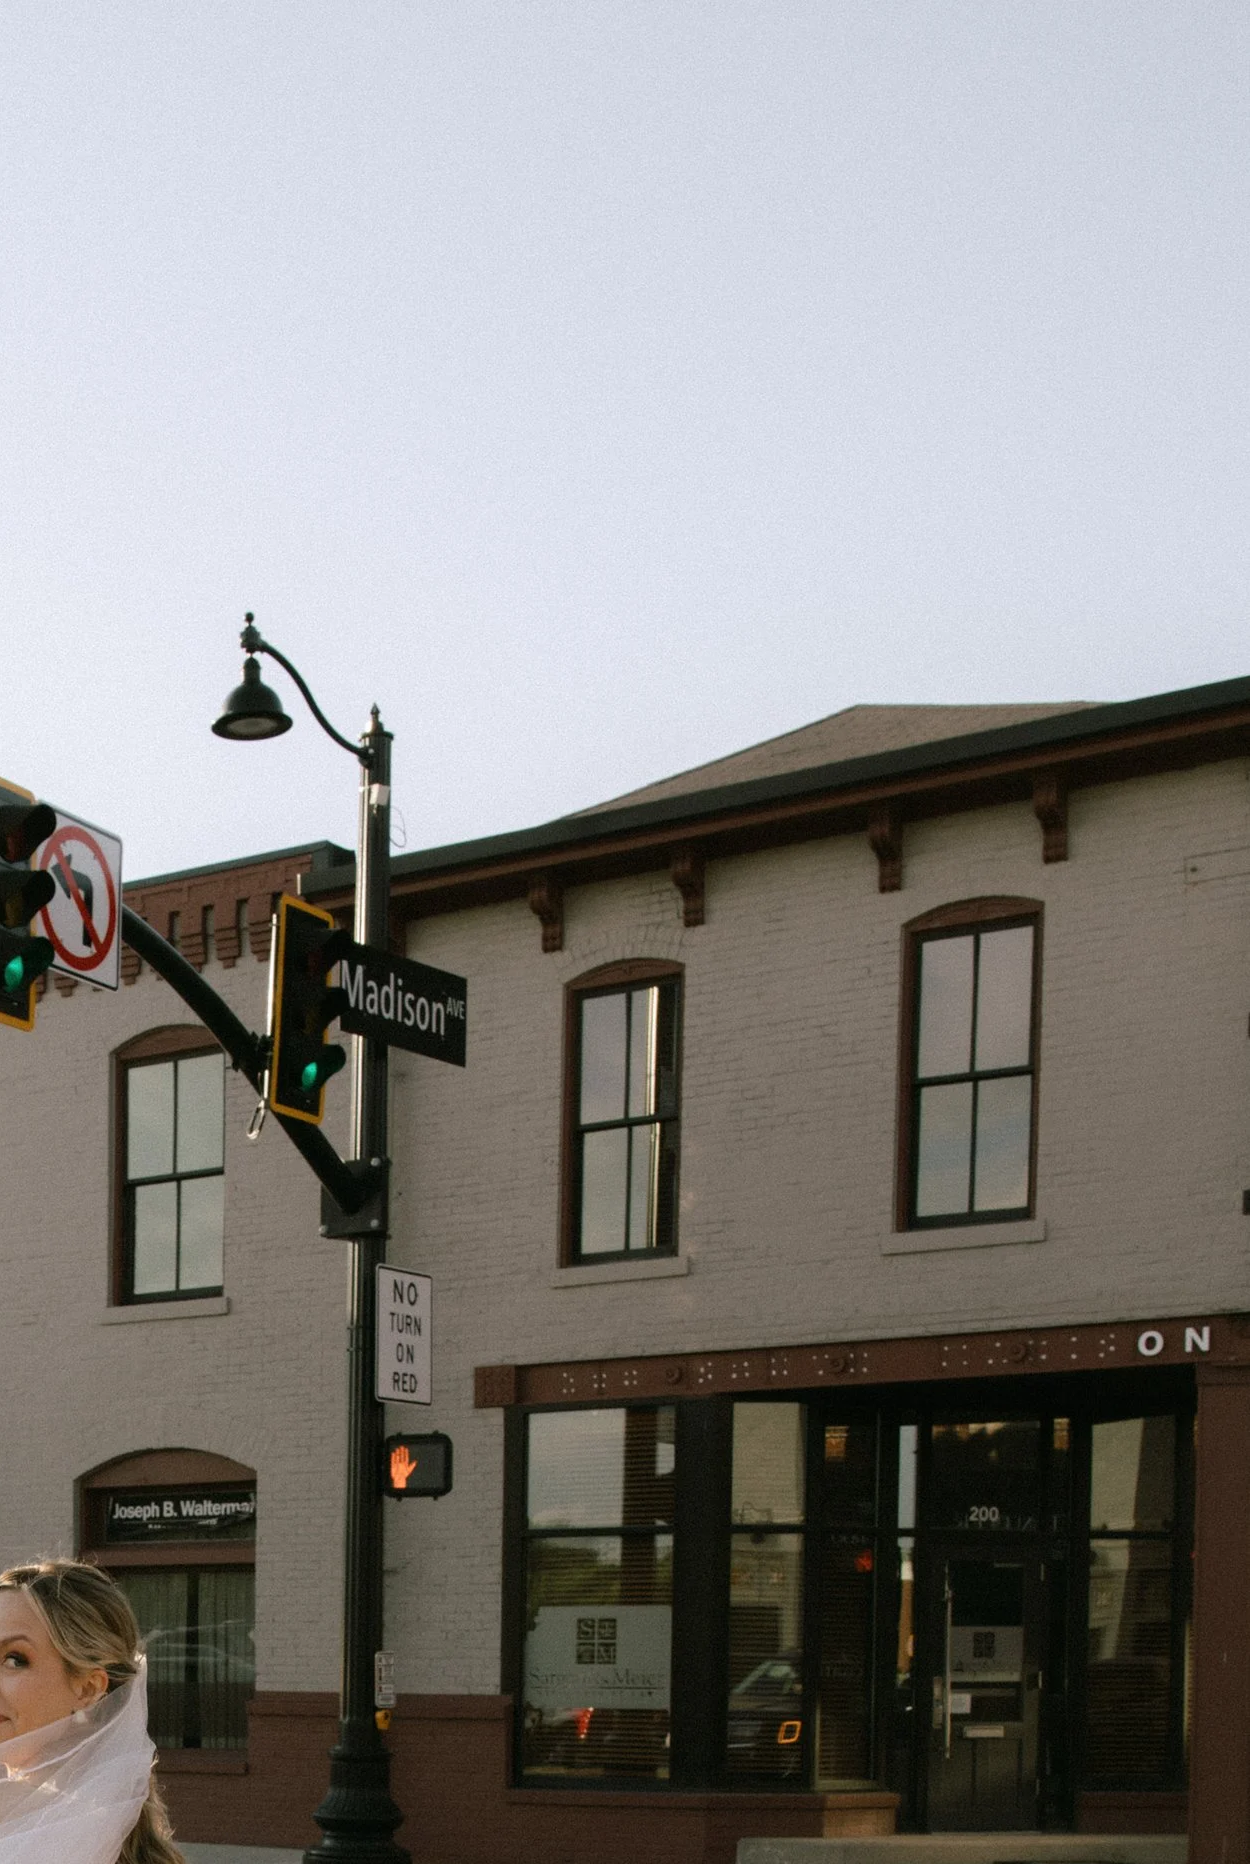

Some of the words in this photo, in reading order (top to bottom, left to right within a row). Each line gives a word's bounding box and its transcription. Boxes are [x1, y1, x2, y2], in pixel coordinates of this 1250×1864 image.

[341, 958, 445, 1036] Madison
[446, 996, 465, 1020] AVE
[393, 1279, 418, 1306] NO
[390, 1312, 422, 1336] TURN
[396, 1342, 415, 1364] ON
[392, 1371, 418, 1394] RED
[113, 1502, 160, 1521] Joseph
[163, 1501, 178, 1518] B.
[969, 1506, 1000, 1522] 200
